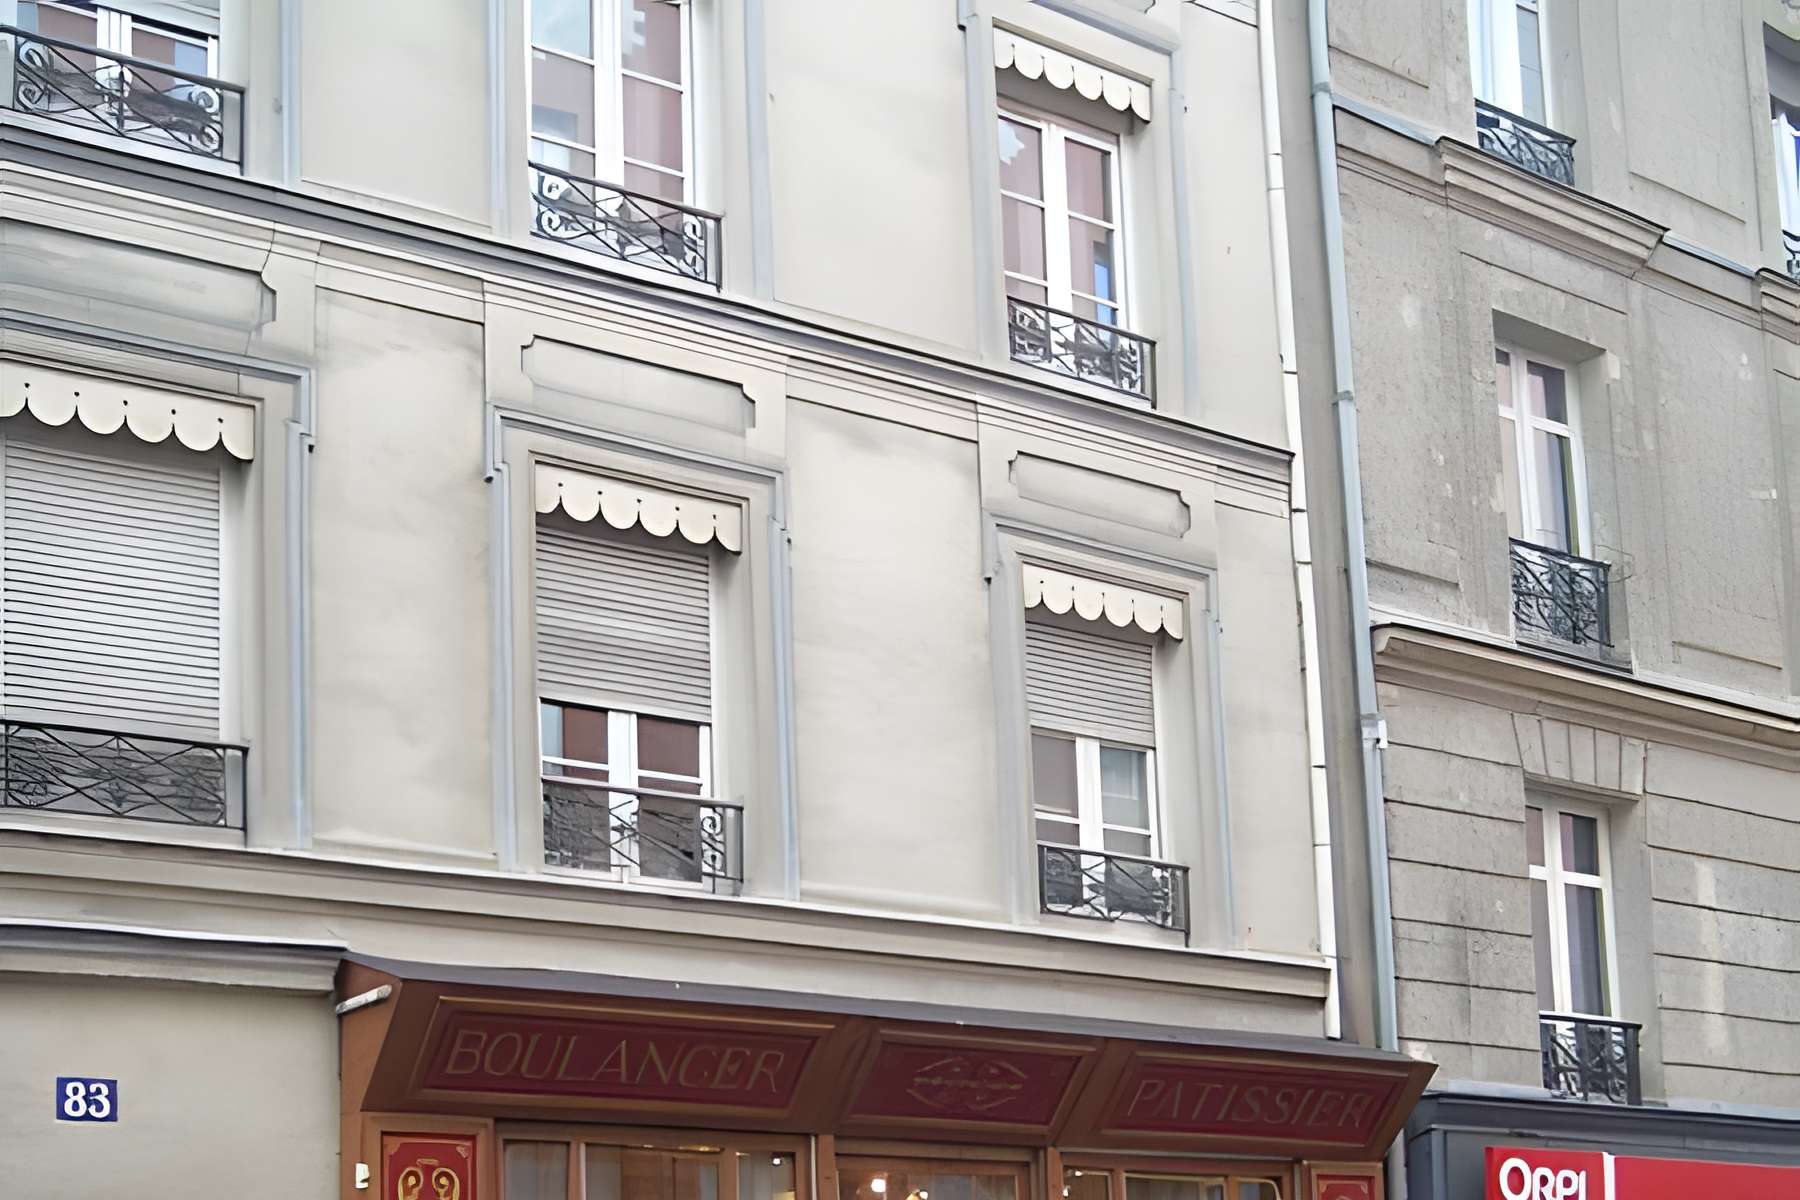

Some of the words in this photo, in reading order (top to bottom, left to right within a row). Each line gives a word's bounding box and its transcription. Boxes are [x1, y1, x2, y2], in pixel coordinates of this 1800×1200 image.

[444, 1028, 786, 1094] BOULANGER
[63, 1081, 111, 1118] 83
[1127, 1079, 1377, 1128] PATISSIER
